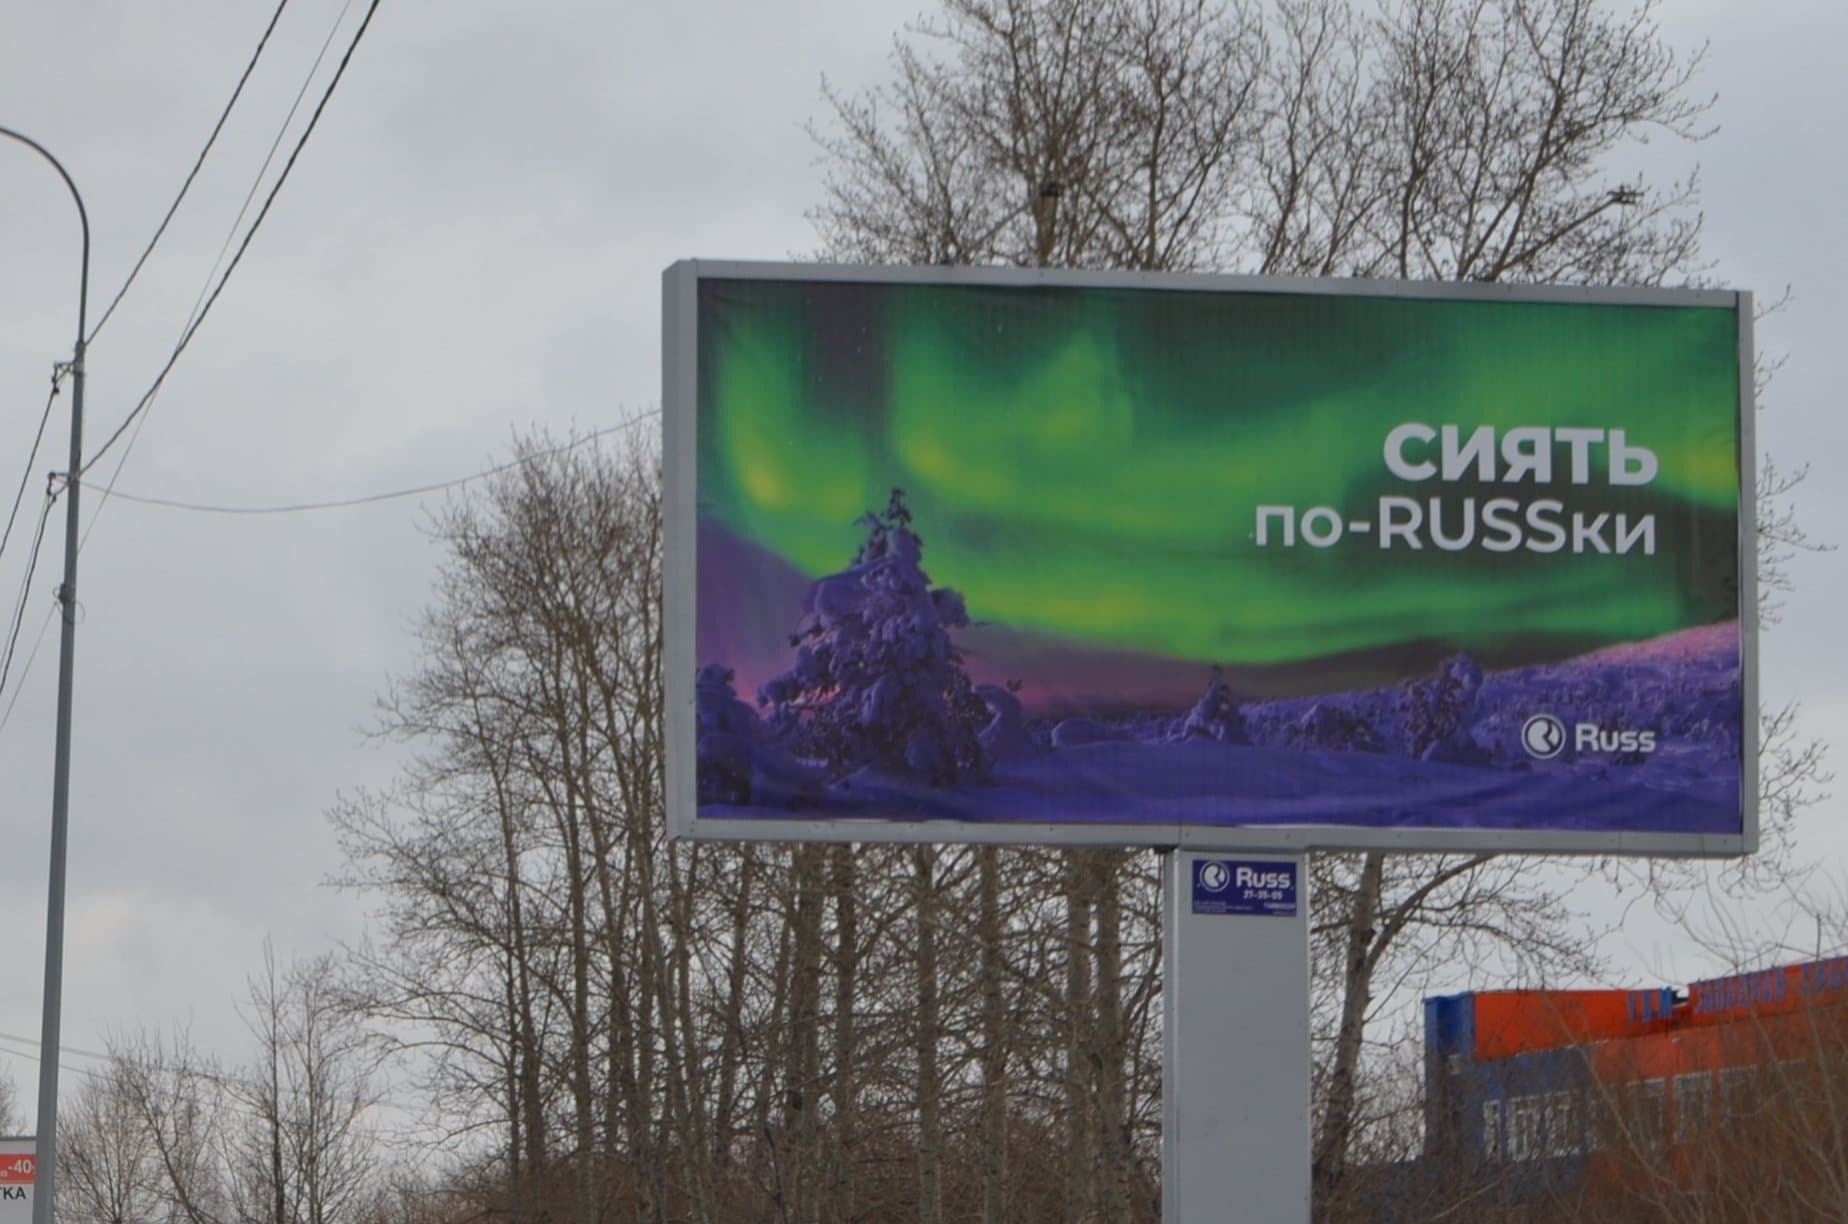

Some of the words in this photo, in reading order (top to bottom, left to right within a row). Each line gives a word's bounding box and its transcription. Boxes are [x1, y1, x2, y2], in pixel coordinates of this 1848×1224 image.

[1255, 496, 1656, 555] по-RUSSки
[1575, 722, 1656, 752] Russ
[1236, 866, 1291, 889] Russ
[7, 1159, 36, 1174] -40
